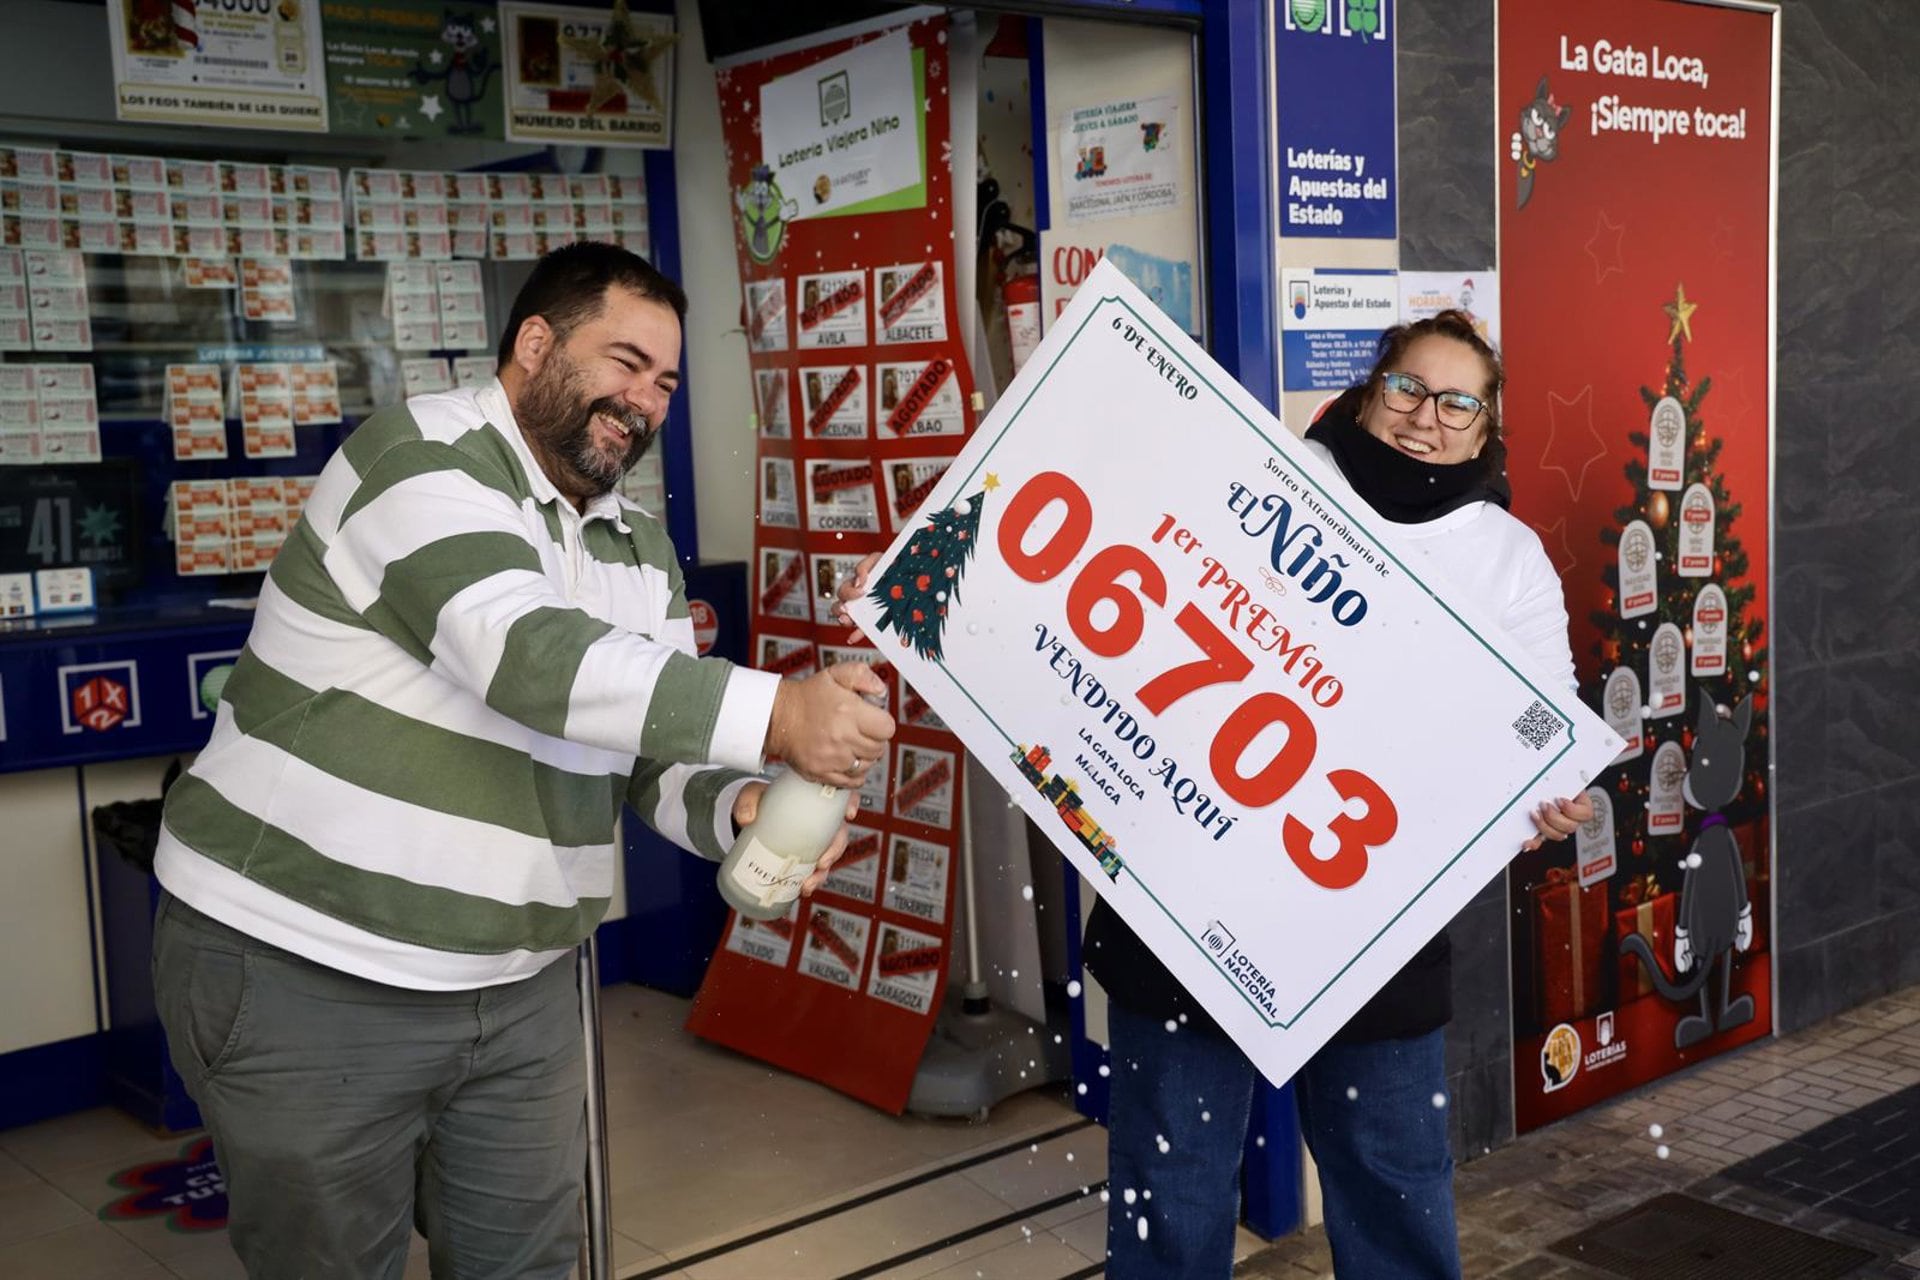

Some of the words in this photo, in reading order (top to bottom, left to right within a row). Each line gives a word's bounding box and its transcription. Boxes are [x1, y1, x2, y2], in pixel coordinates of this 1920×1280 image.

[1560, 35, 1588, 71] La
[1593, 39, 1648, 78] Gata
[1652, 46, 1709, 89] Loca,
[120, 95, 145, 106] LOS
[150, 96, 180, 108] FEOS
[238, 102, 251, 112] SE
[255, 103, 277, 114] LES
[279, 105, 321, 117] QUIERE
[579, 118, 606, 131] DEL
[609, 120, 662, 133] BARRIO
[1591, 95, 1690, 144] ¡Siempre
[1693, 106, 1746, 139] toca!
[826, 126, 869, 154] Viajera
[1287, 148, 1351, 172] Loterías
[1351, 154, 1365, 176] y
[1289, 175, 1362, 202] Apuestas
[1363, 178, 1387, 200] del
[1289, 203, 1343, 225] Estado
[1314, 298, 1350, 311] Apuestas
[1352, 298, 1364, 309] del
[1366, 298, 1391, 309] Estado
[885, 326, 934, 342] ALBACETE
[1112, 317, 1123, 330] 6
[1123, 325, 1148, 353] DE
[1147, 346, 1199, 401] ENERO
[892, 360, 946, 434] AGOTADO
[1227, 481, 1259, 520] El
[1264, 457, 1298, 493] Sorteo
[1301, 488, 1375, 565] Extraordinario
[1375, 560, 1391, 579] de
[26, 497, 73, 565] 41
[1240, 494, 1369, 628] Niño
[1151, 512, 1205, 556] 1er
[1197, 556, 1345, 709] PREMIO
[997, 471, 1399, 890] 06703
[1035, 623, 1156, 761] VENDIDO
[1148, 757, 1239, 842] AQUÍ
[1078, 727, 1094, 745] LA
[1092, 742, 1119, 773] GATA
[1117, 769, 1145, 801] LOCA
[874, 982, 923, 1009] ZARAGOZA
[1224, 957, 1278, 1018] NACIONAL
[1232, 949, 1276, 999] LOTERÍA
